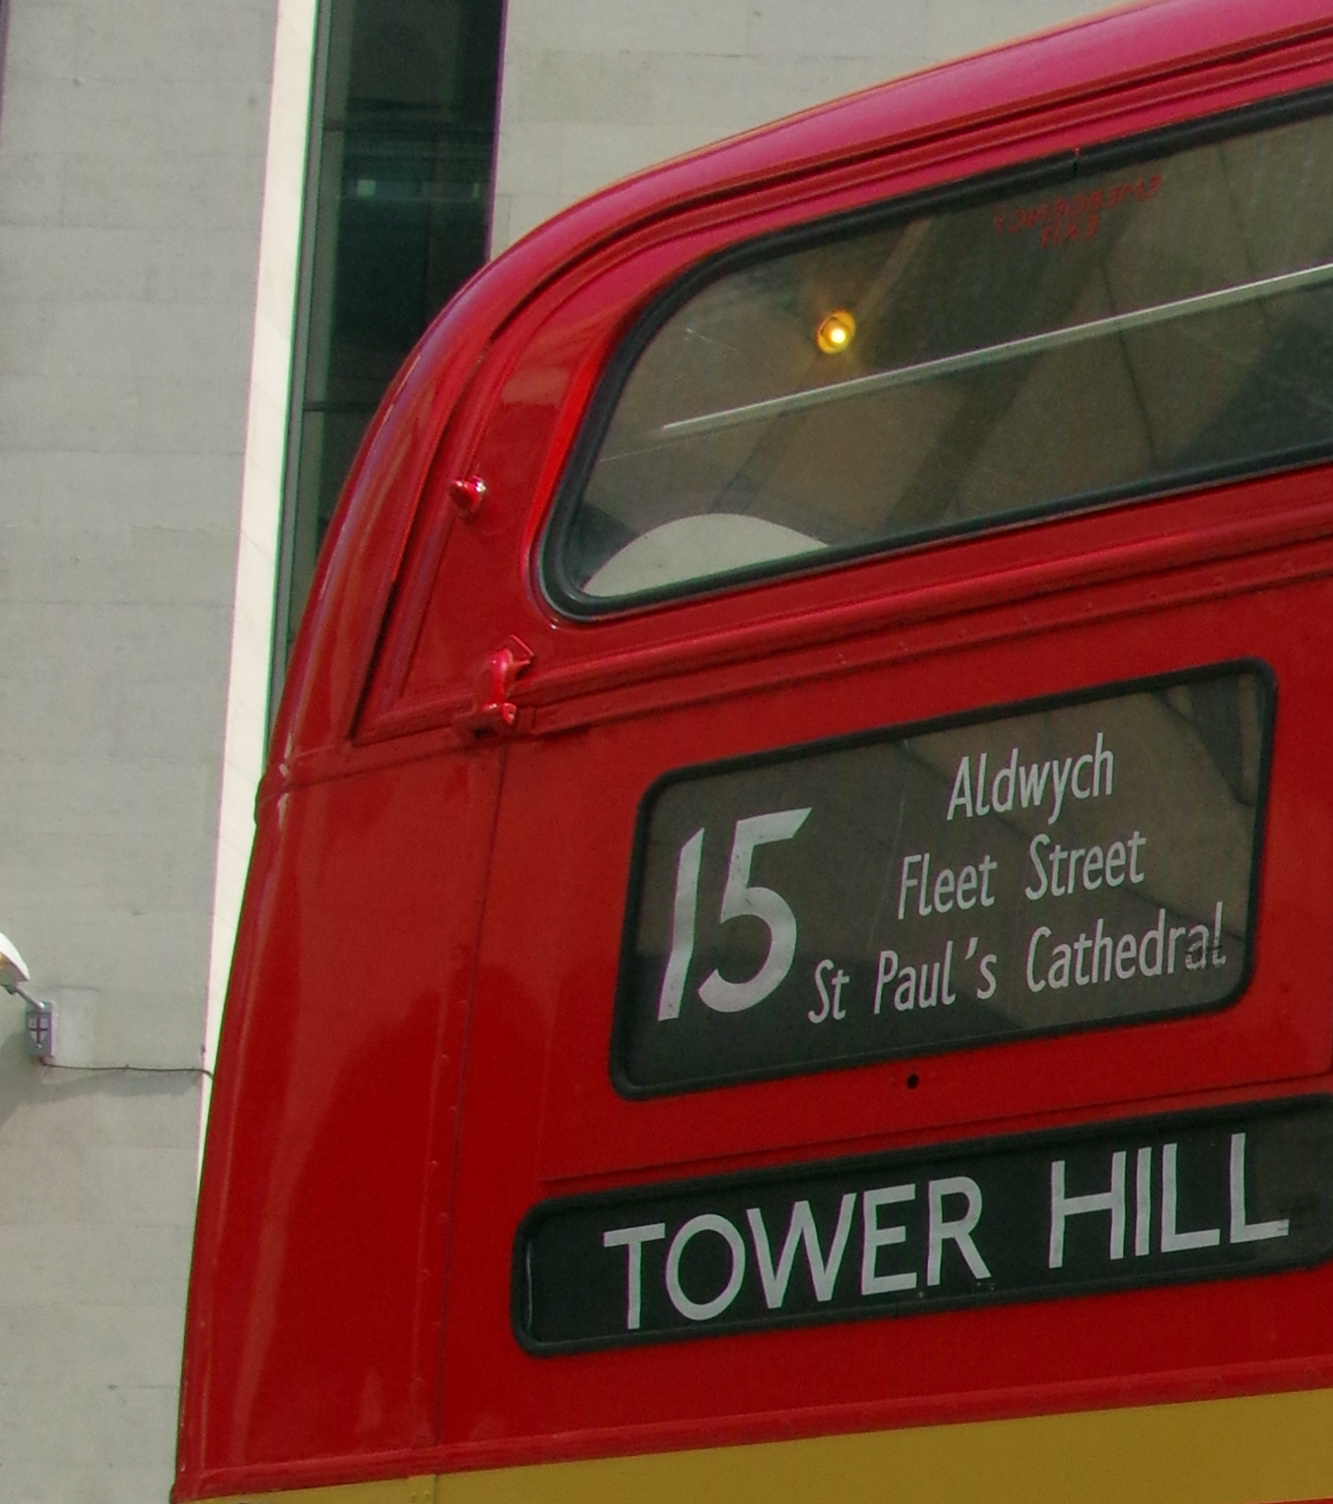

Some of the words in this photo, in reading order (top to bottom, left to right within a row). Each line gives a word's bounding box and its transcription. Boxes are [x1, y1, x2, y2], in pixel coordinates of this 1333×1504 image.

[947, 732, 1114, 823] Aldwych
[658, 807, 812, 1022] 15
[898, 852, 996, 921] Fleet
[1026, 830, 1147, 903] Street
[808, 958, 850, 1024] St
[874, 936, 999, 1017] Paul's
[1027, 901, 1226, 994] Cathedral
[603, 1176, 991, 1330] TOWER
[1048, 1133, 1290, 1269] HILL
